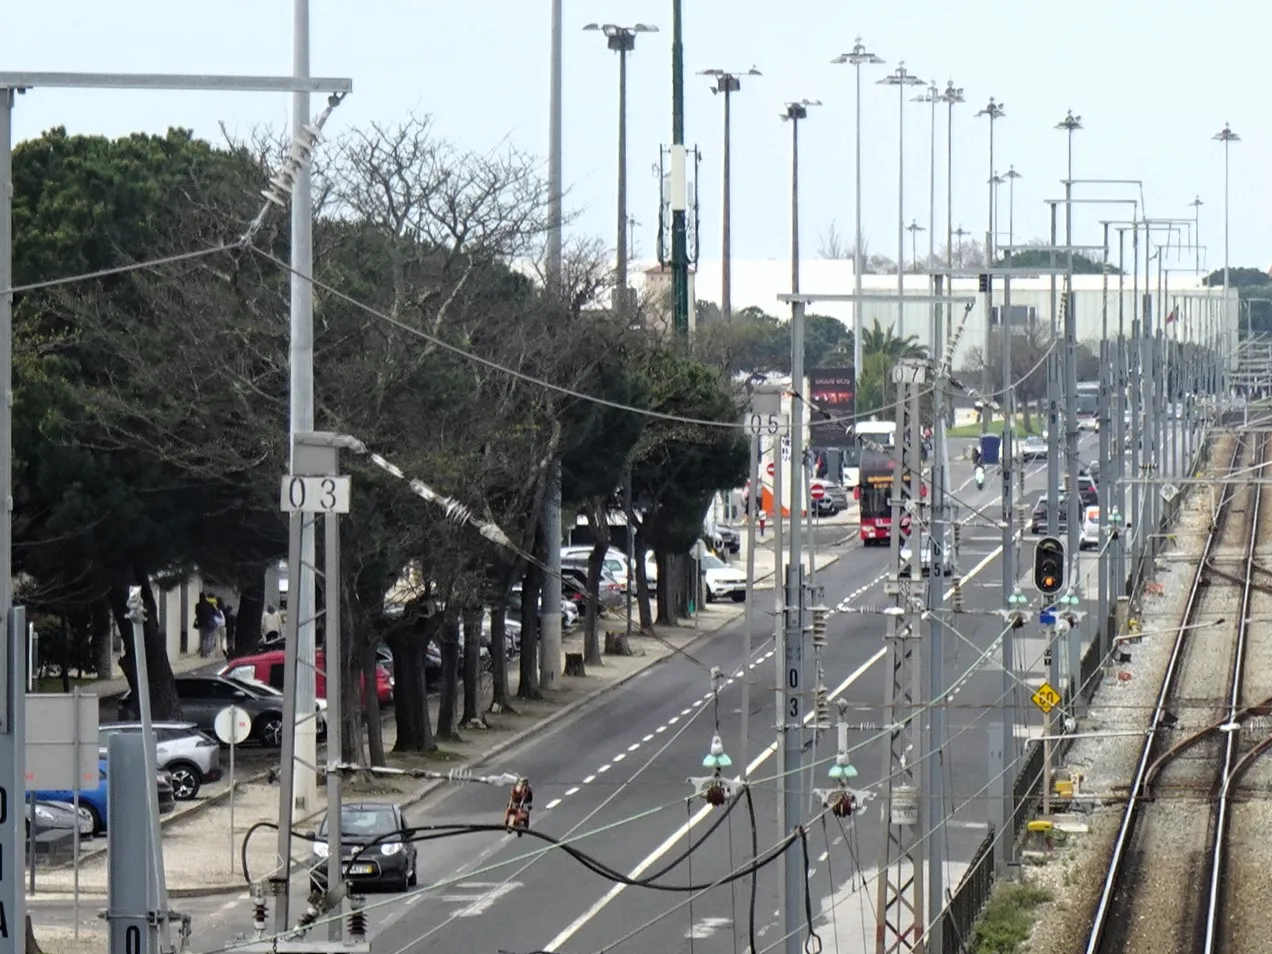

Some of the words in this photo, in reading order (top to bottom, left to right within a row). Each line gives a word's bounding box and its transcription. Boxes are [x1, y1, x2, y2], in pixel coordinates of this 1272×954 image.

[751, 415, 778, 434] 05
[289, 477, 336, 509] 03
[789, 668, 798, 717] 03
